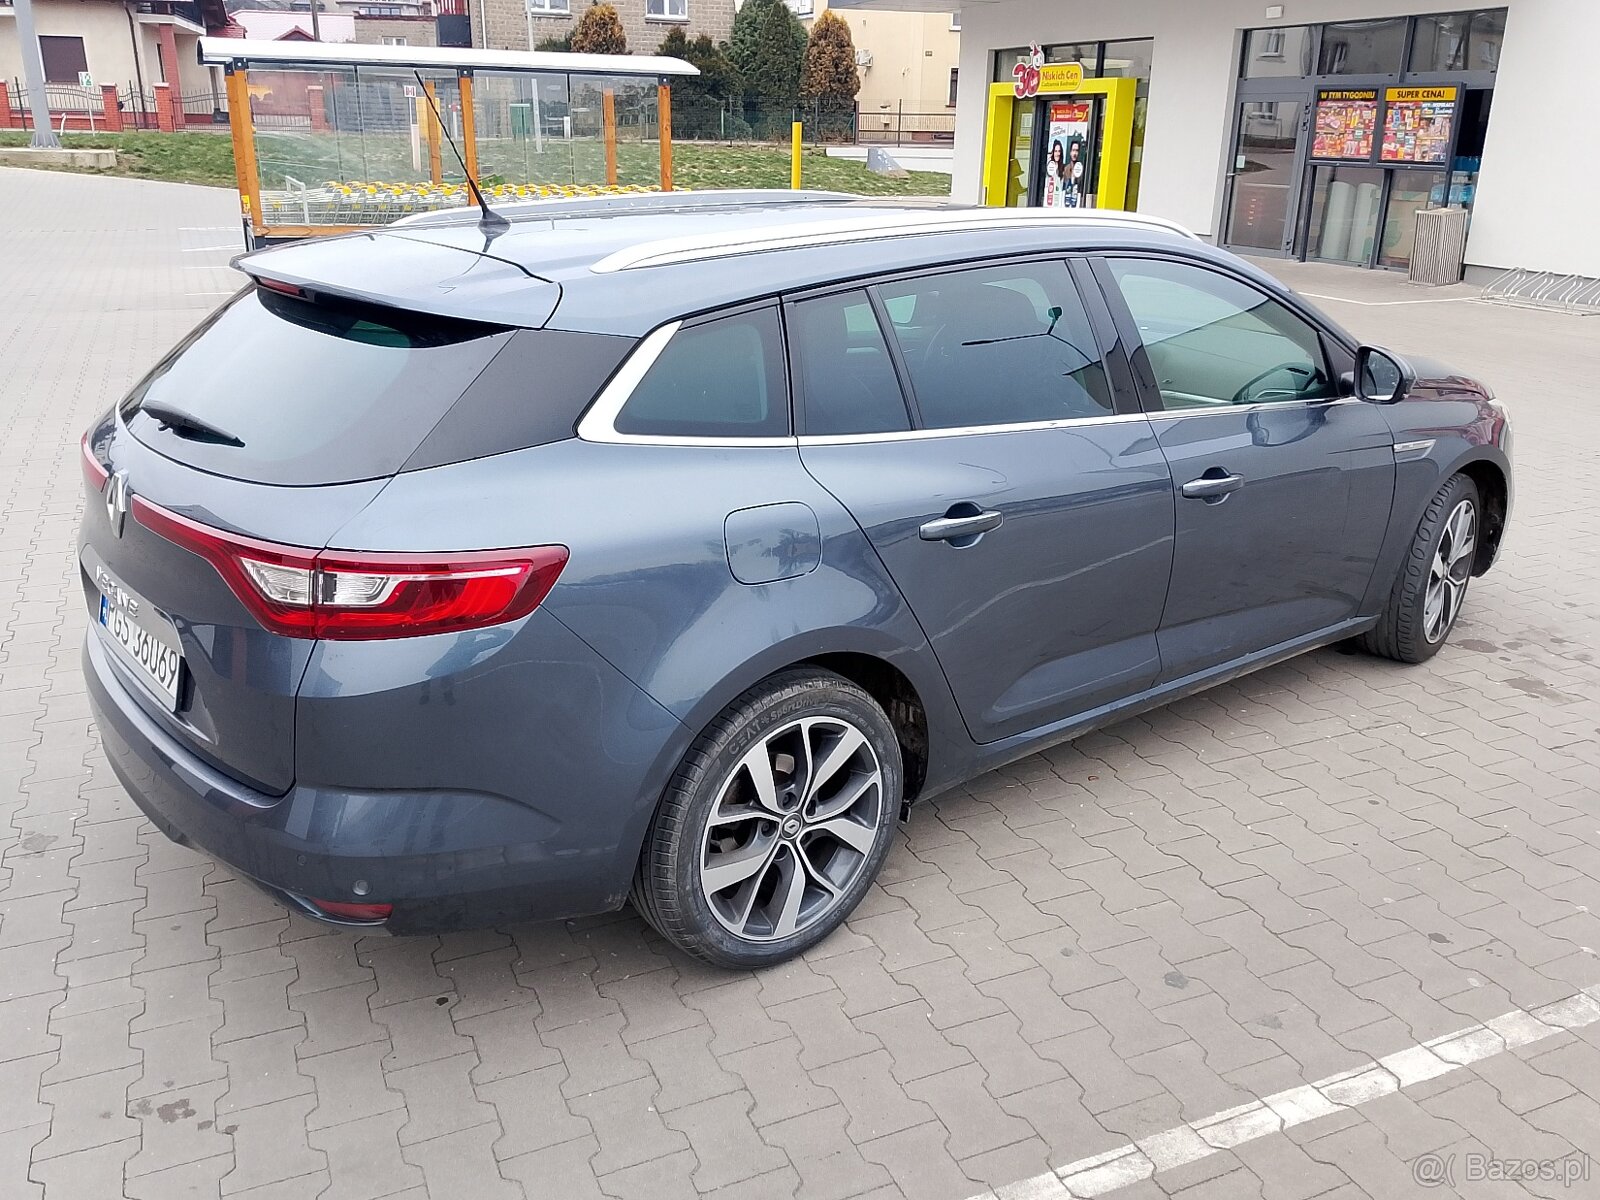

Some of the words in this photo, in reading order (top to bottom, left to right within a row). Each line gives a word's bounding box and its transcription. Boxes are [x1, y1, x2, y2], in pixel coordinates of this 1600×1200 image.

[1042, 71, 1066, 81] Niskich
[1066, 70, 1078, 80] Cen
[1320, 91, 1328, 99] W
[1397, 90, 1420, 99] SUPER
[1421, 90, 1445, 99] CENA!
[133, 628, 178, 690] 36069
[728, 718, 762, 756] CEAT
